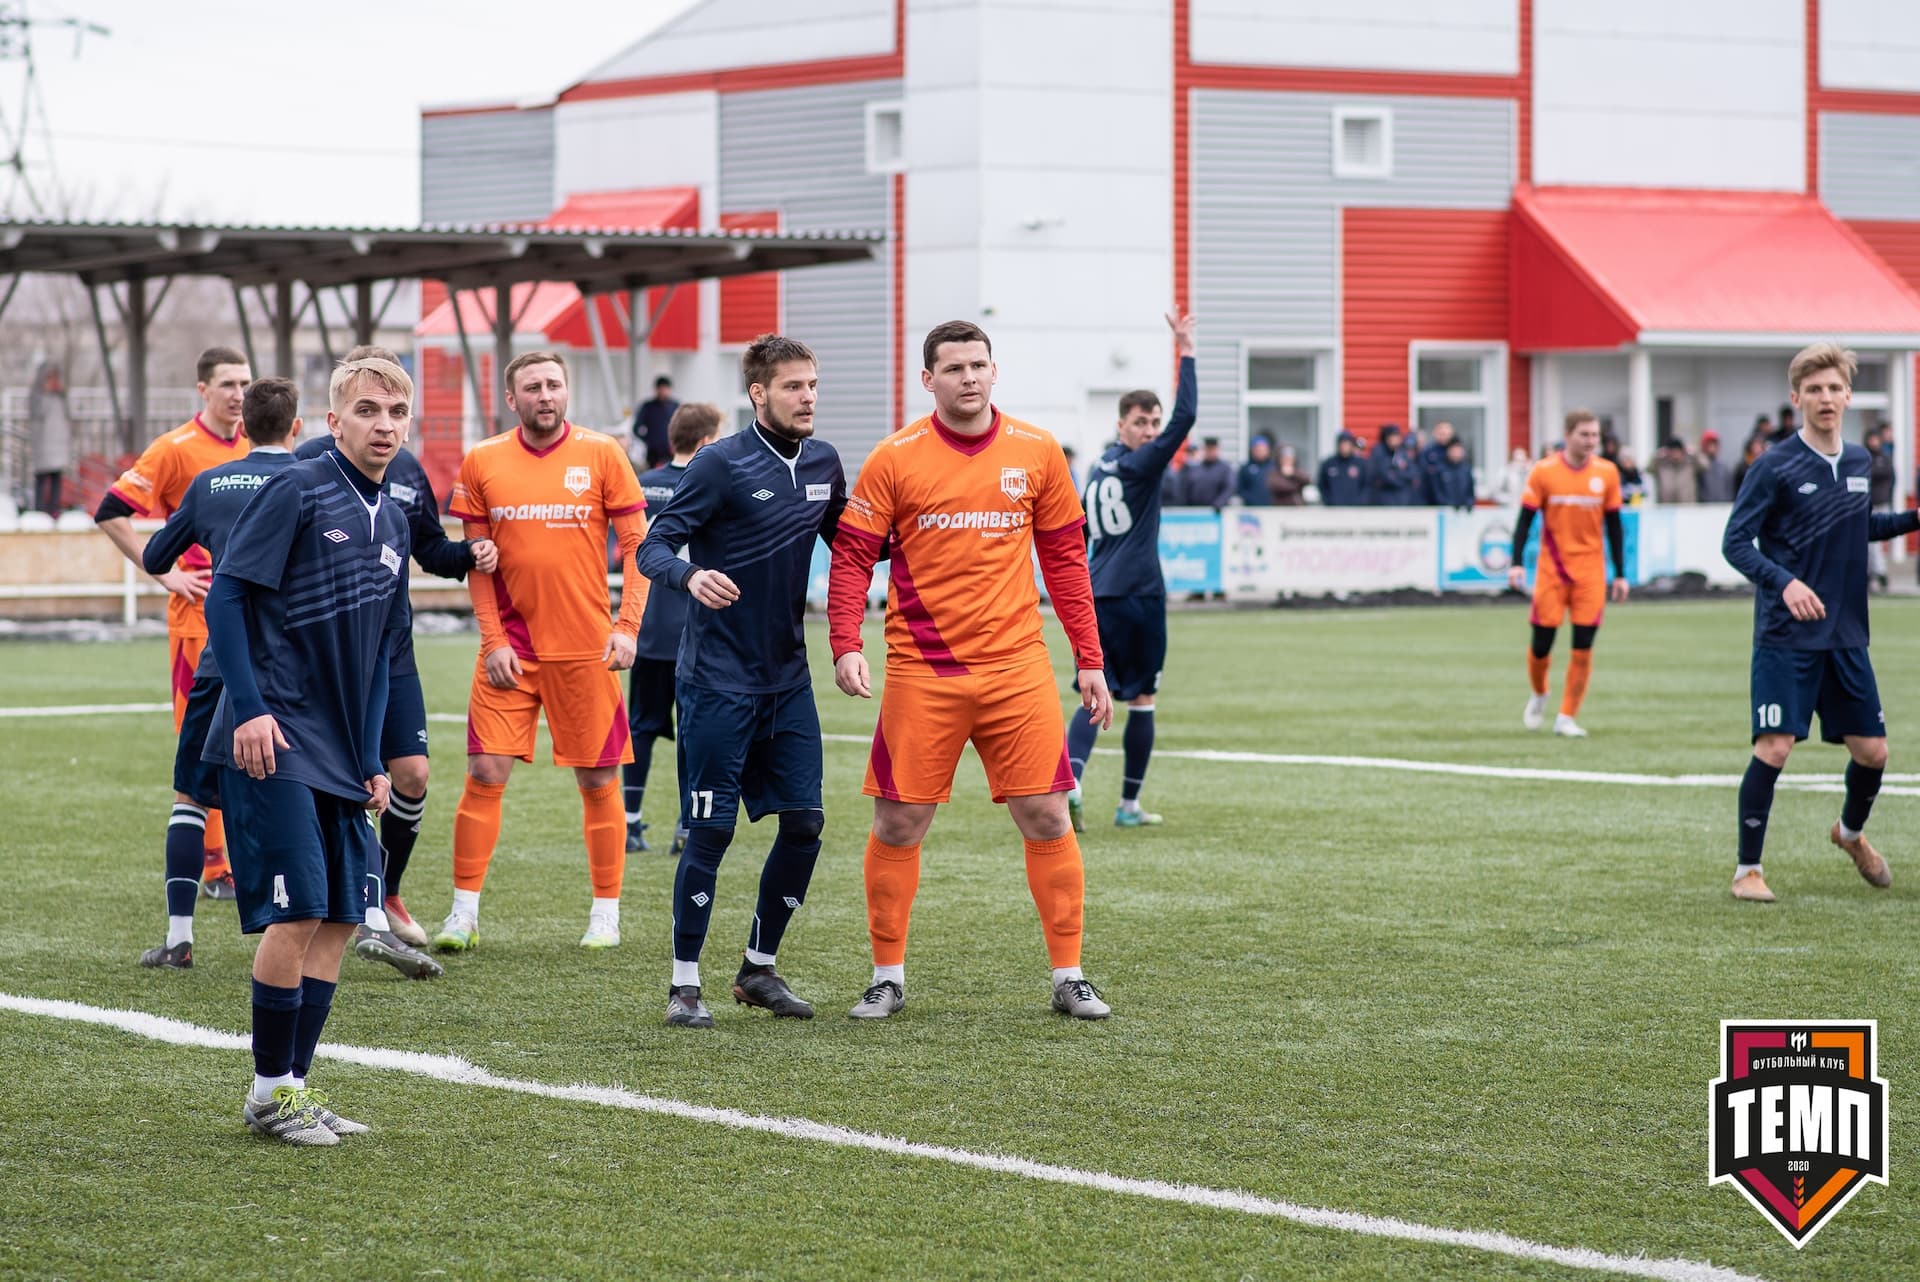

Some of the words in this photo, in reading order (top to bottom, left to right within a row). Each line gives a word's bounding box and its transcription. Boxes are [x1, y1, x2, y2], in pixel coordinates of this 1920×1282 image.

[490, 504, 592, 522] ПРОДИНВЕСТ
[917, 511, 1026, 530] ПРОДИНВЕСТ
[1086, 475, 1133, 540] 18
[1757, 703, 1782, 728] 10
[690, 790, 713, 819] 17
[273, 874, 289, 909] 4
